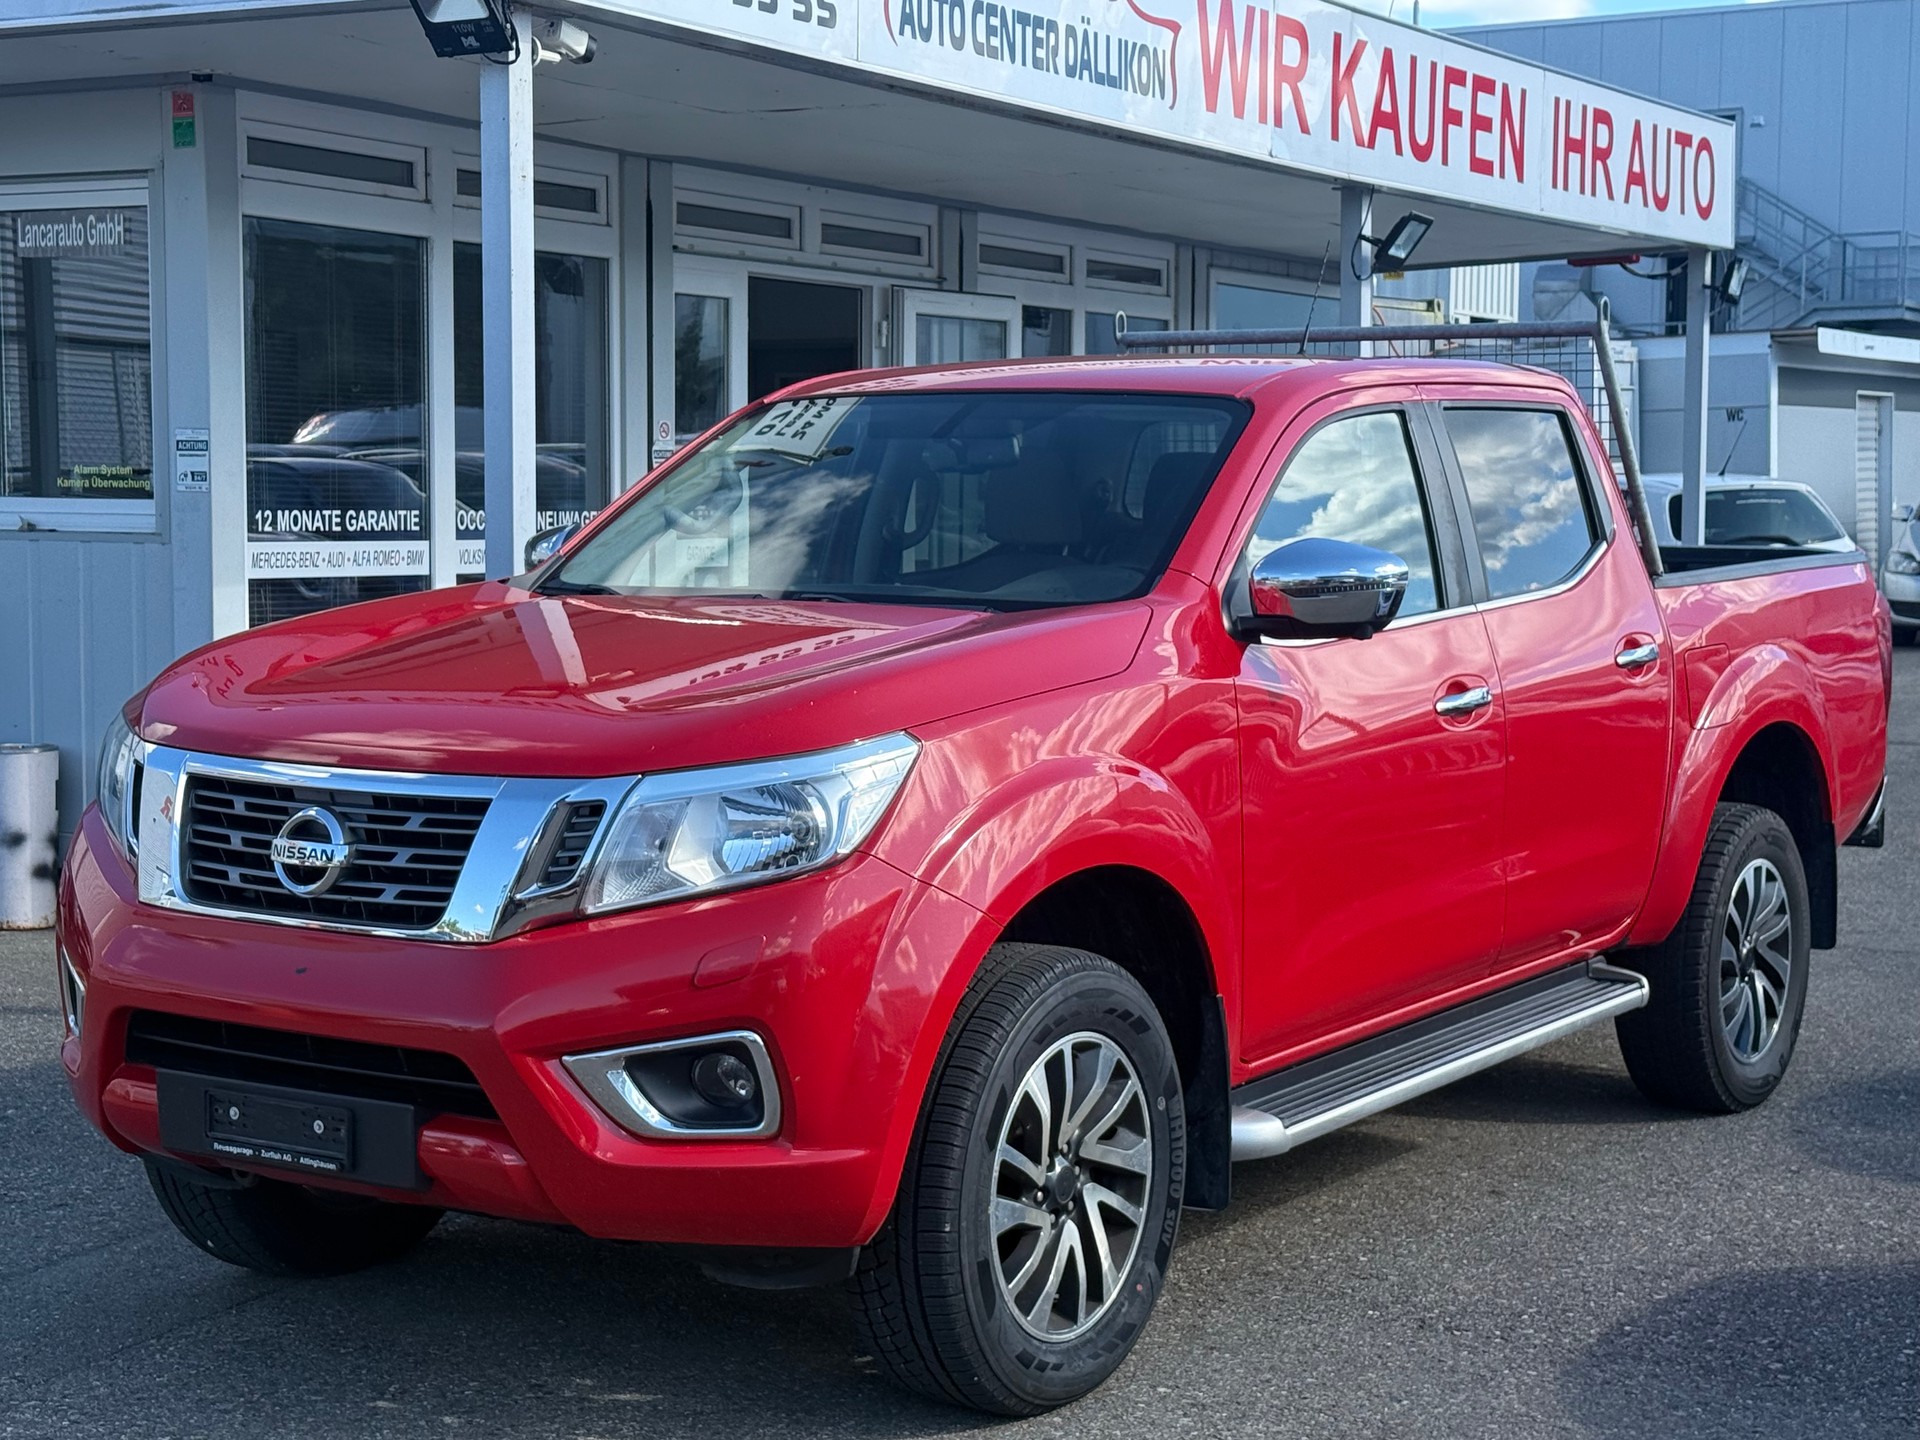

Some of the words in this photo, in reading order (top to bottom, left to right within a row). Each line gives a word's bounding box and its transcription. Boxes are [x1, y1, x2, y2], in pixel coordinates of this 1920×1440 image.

[899, 0, 966, 51] AUTO
[971, 0, 1060, 75] CENTER
[1065, 16, 1166, 101] DÄLLIKON
[1198, 0, 1311, 136] WIR
[1330, 31, 1527, 184] KAUFEN
[1551, 96, 1615, 201] IHR
[1624, 118, 1716, 221] AUTO
[18, 216, 84, 248] Lancarauto
[87, 213, 124, 246] GmbH
[1725, 407, 1744, 422] WC
[178, 441, 207, 450] ACHTUNG
[73, 464, 99, 475] Alarm
[100, 464, 133, 476] System
[57, 477, 90, 488] Kamera
[91, 475, 150, 491] Überwachung
[255, 509, 273, 532] 12
[277, 509, 342, 532] MONATE
[345, 509, 420, 532] GARANTIE
[251, 551, 321, 569] MERCEDES-BENZ
[326, 551, 346, 568] AUDI
[352, 550, 371, 567] ALFA
[373, 549, 400, 566] ROMEO
[406, 549, 425, 566] BMW
[272, 843, 335, 862] NISSAN
[282, 1153, 292, 1162] AG
